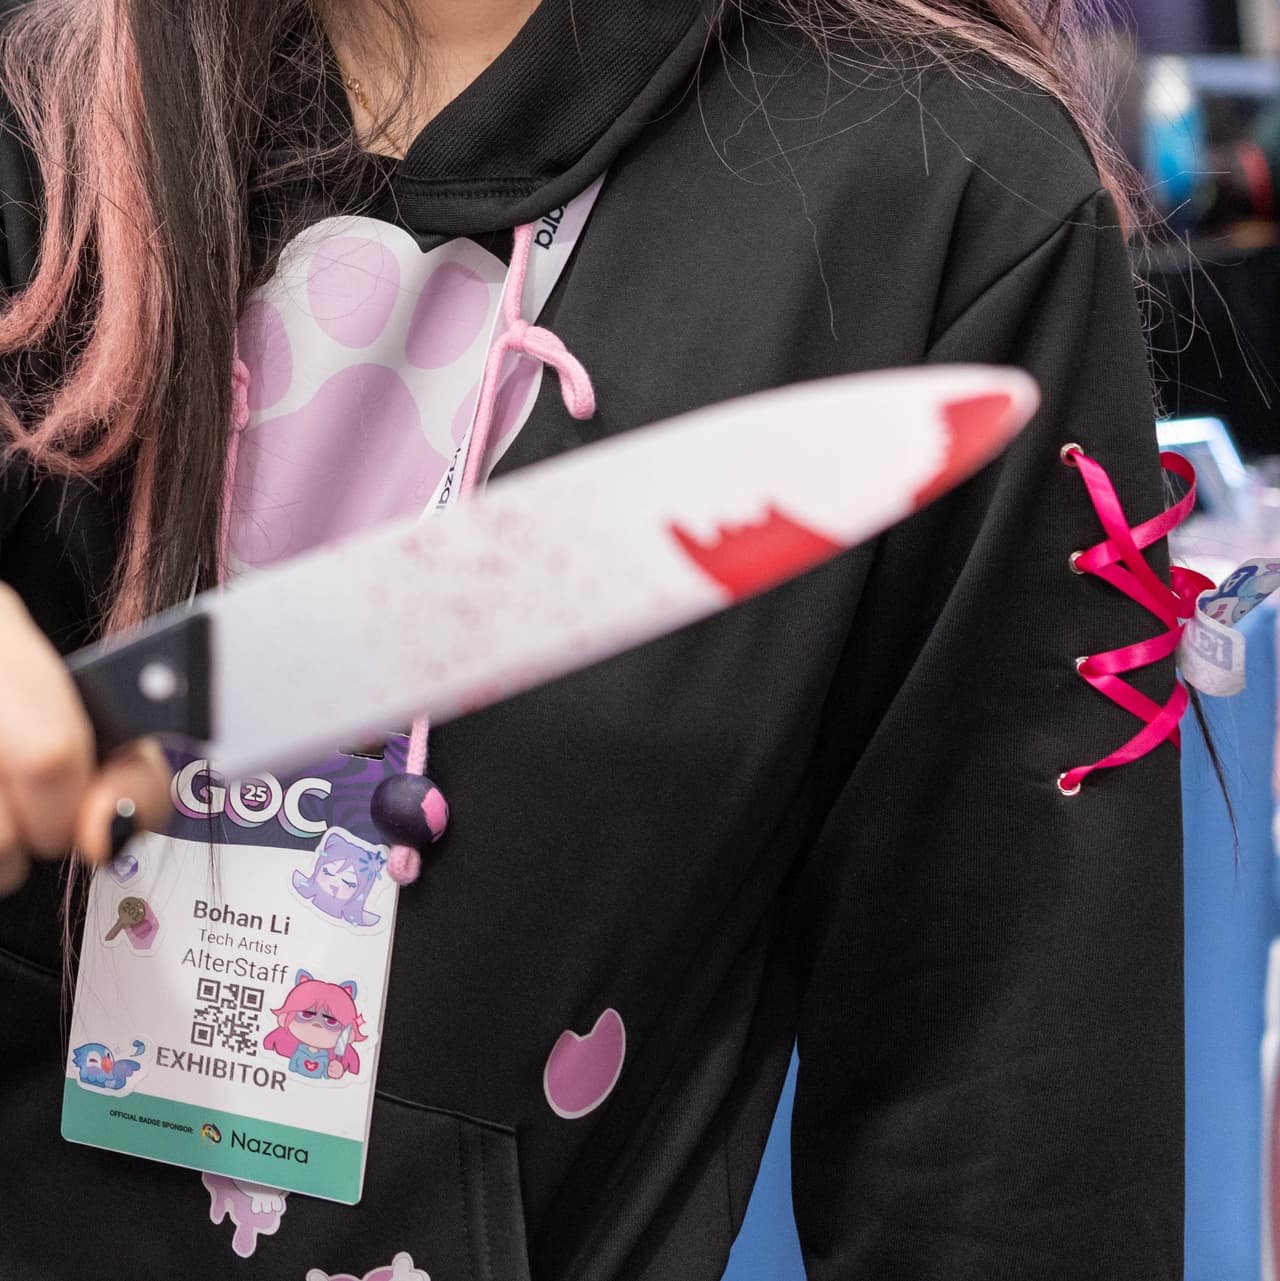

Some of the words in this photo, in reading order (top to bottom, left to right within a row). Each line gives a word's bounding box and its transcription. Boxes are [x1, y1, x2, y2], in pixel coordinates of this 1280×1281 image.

[244, 784, 268, 803] 25
[193, 899, 263, 930] Bohan
[270, 914, 291, 935] Li
[199, 928, 234, 947] Tech
[238, 937, 278, 956] Artist
[181, 948, 289, 985] AlterStaff
[156, 1046, 287, 1092] EXHIBITOR
[109, 1109, 138, 1123] OFFICIAL
[139, 1115, 161, 1128] BADGE
[162, 1120, 194, 1134] SPONSOR:
[231, 1130, 309, 1164] Nazara
